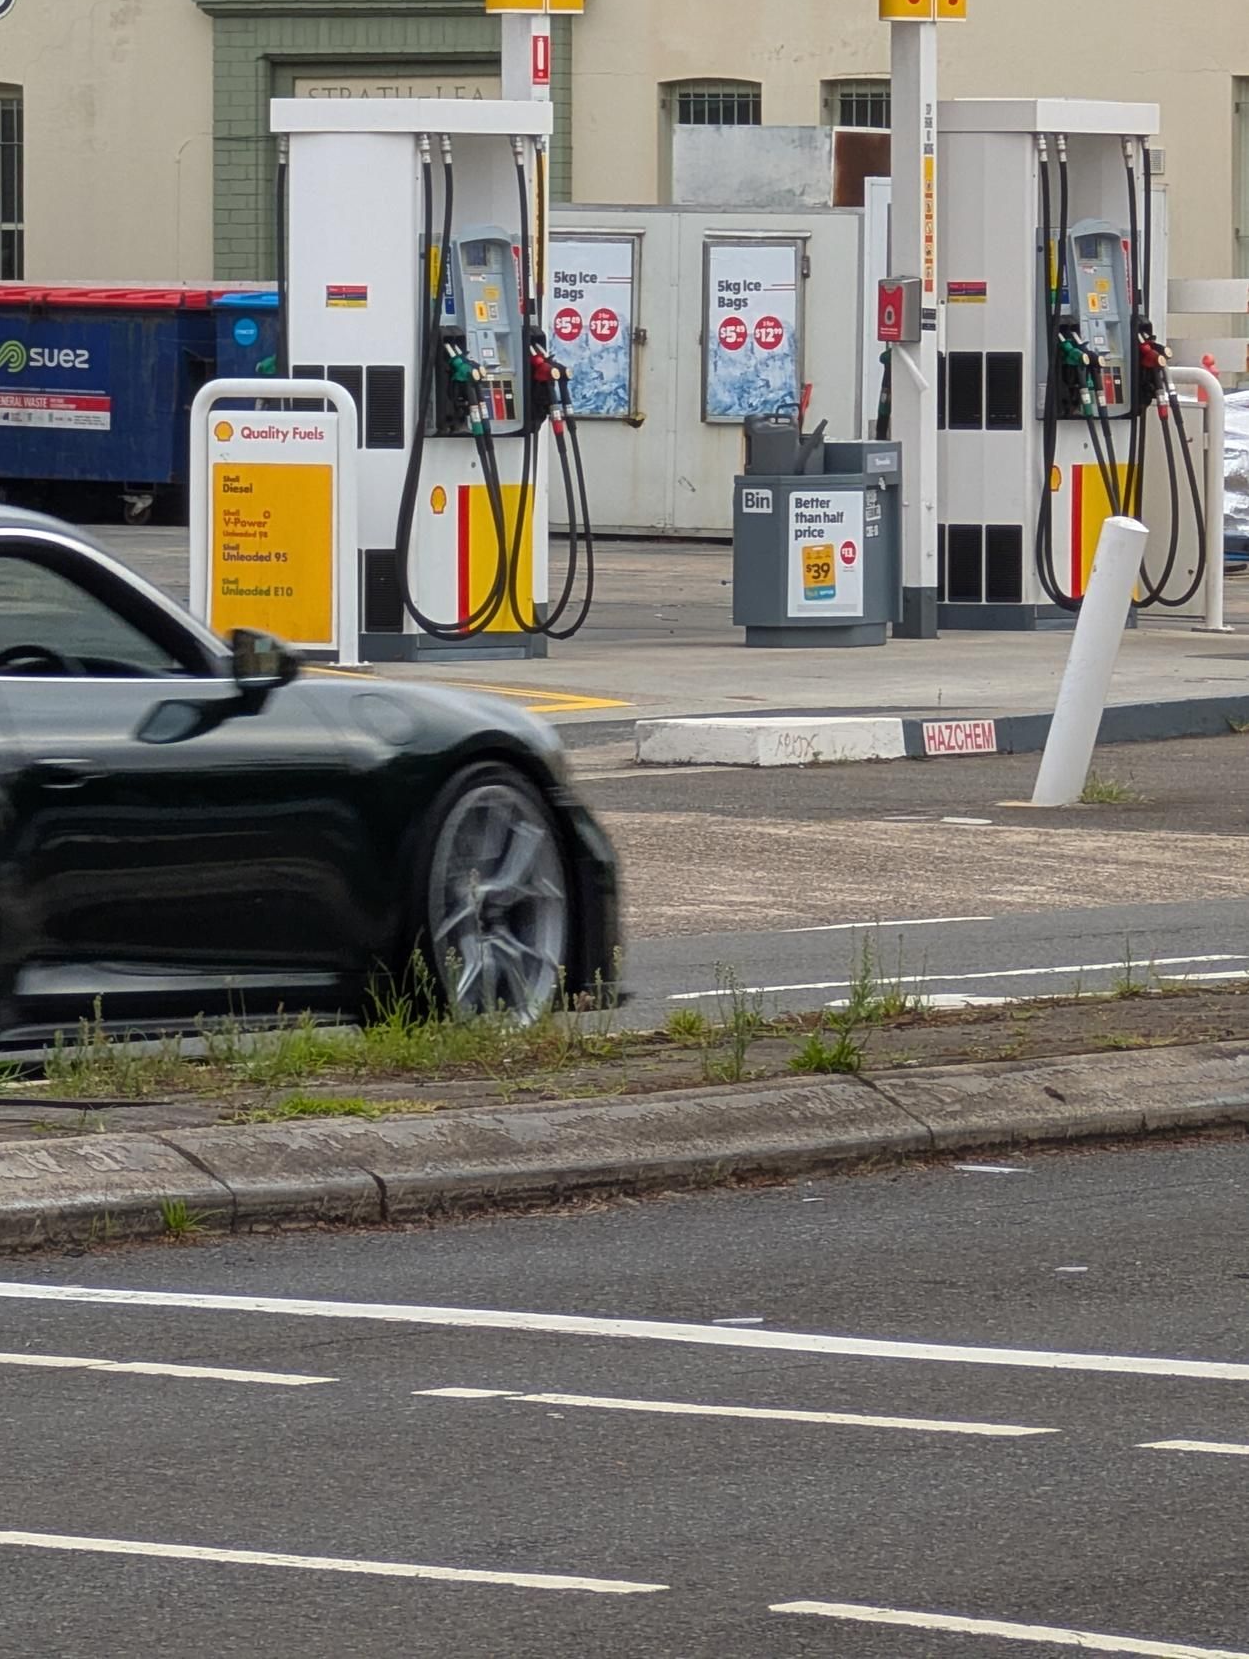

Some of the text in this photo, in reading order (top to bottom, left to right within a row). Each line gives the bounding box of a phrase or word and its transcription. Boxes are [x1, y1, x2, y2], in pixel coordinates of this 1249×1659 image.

[553, 271, 598, 287] 5kg Ice
[553, 287, 584, 302] Bags
[717, 280, 762, 296] 5kg Ice
[717, 296, 748, 311] Bags
[29, 348, 90, 370] suez
[24, 396, 48, 409] WASTE
[240, 426, 325, 443] Quality Fuels
[223, 484, 254, 494] Diesel
[744, 492, 771, 509] Bin
[794, 497, 831, 509] Better
[224, 518, 269, 529] V-Power
[795, 511, 844, 524] than half
[794, 526, 825, 540] price
[222, 552, 288, 563] Unleaded 95
[806, 562, 831, 580] $39
[222, 586, 294, 598] Unleaded E10
[925, 722, 995, 753] HAZCHEM
